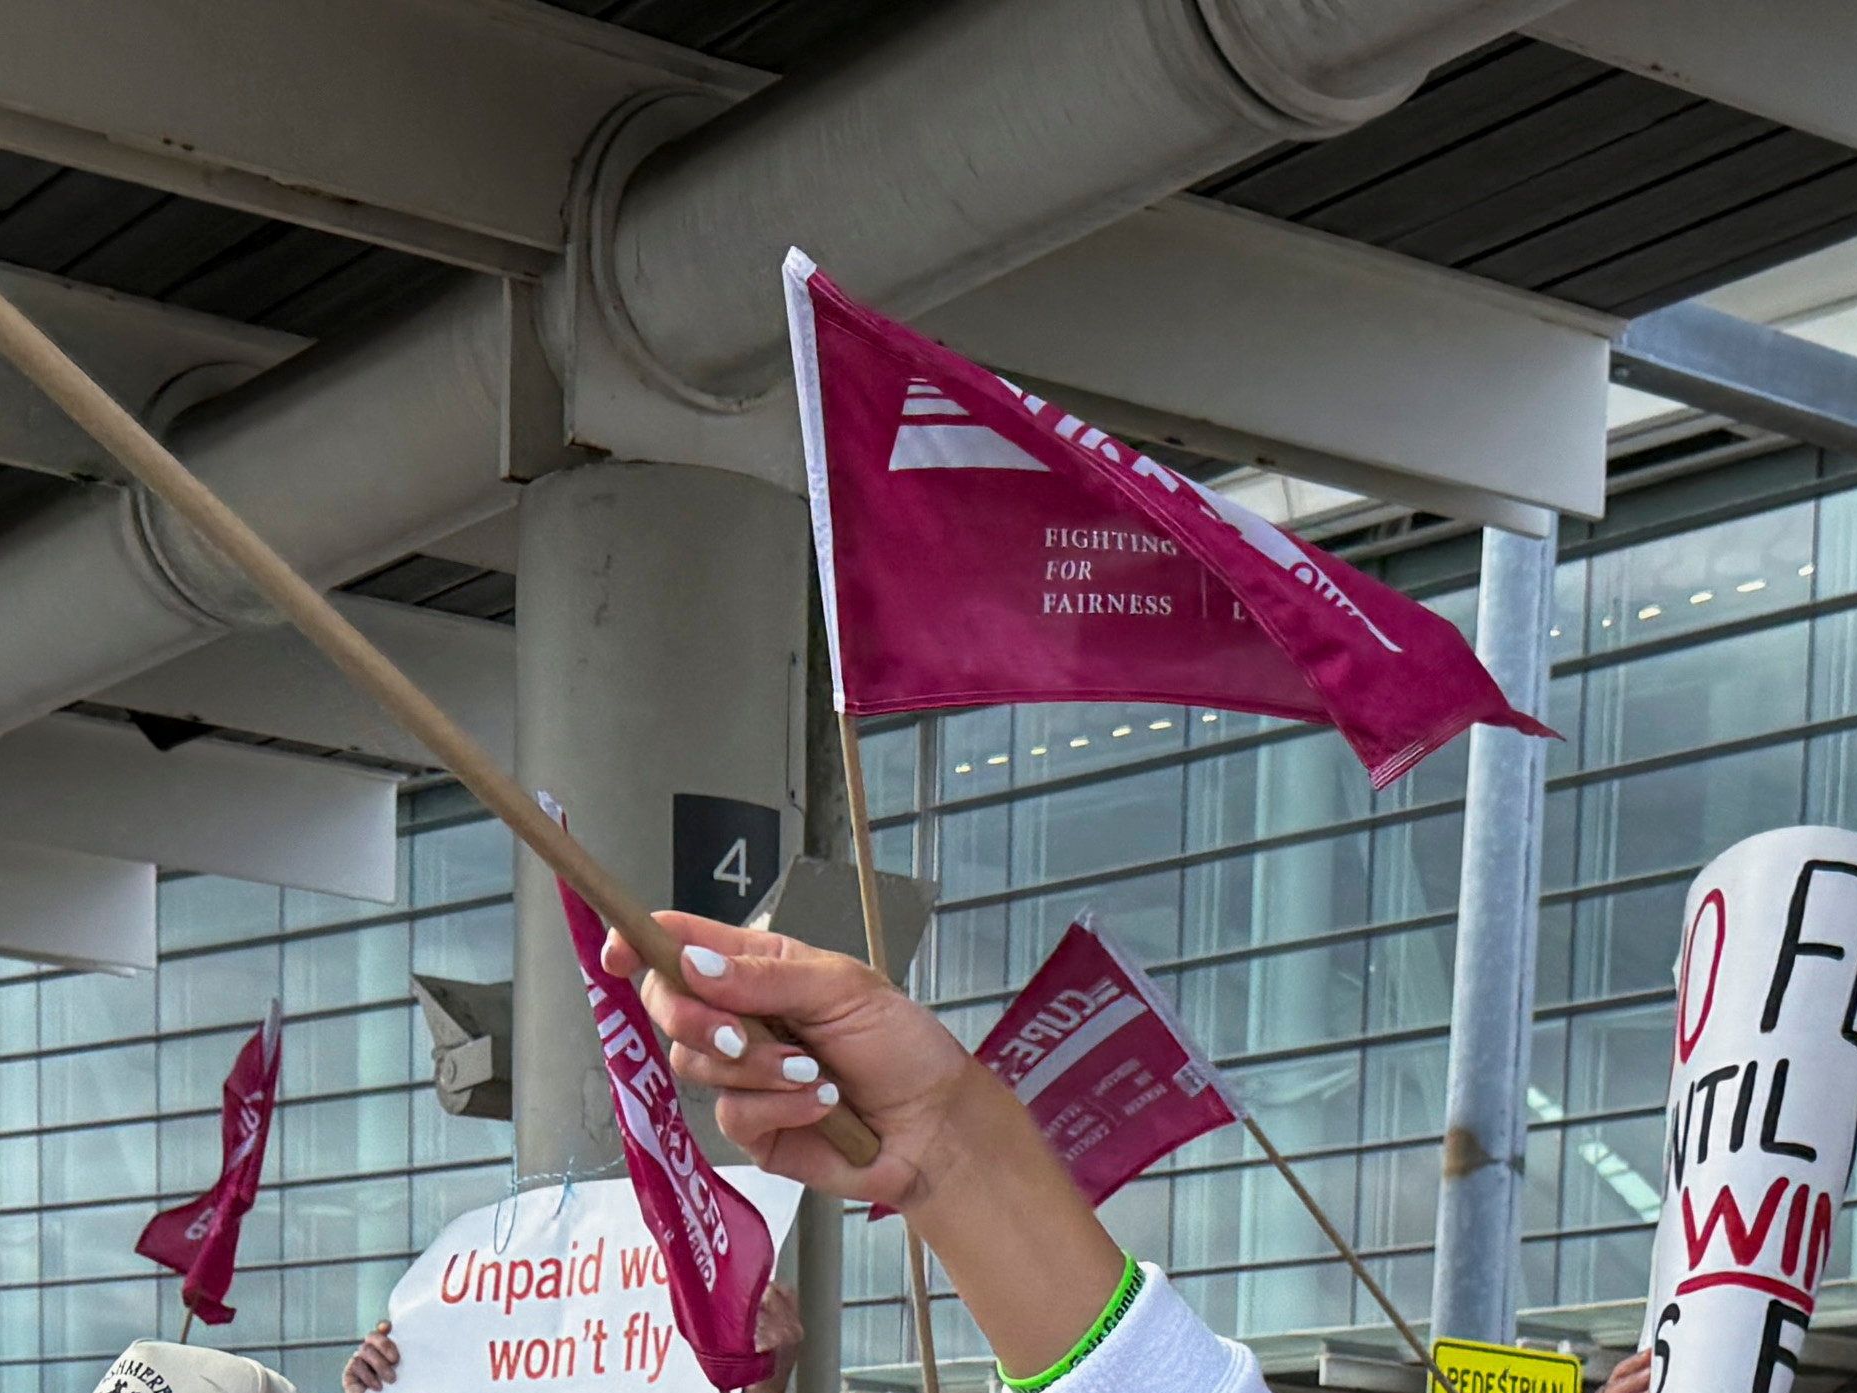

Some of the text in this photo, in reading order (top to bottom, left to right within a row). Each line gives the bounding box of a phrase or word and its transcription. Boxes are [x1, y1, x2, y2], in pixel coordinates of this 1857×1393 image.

[1044, 527, 1178, 556] FIGHTING
[1045, 560, 1093, 581] FOR
[1043, 593, 1173, 616] FAIRNESS
[713, 837, 752, 897] 4
[441, 1237, 605, 1314] Unpaid
[489, 1312, 674, 1384] won't fly
